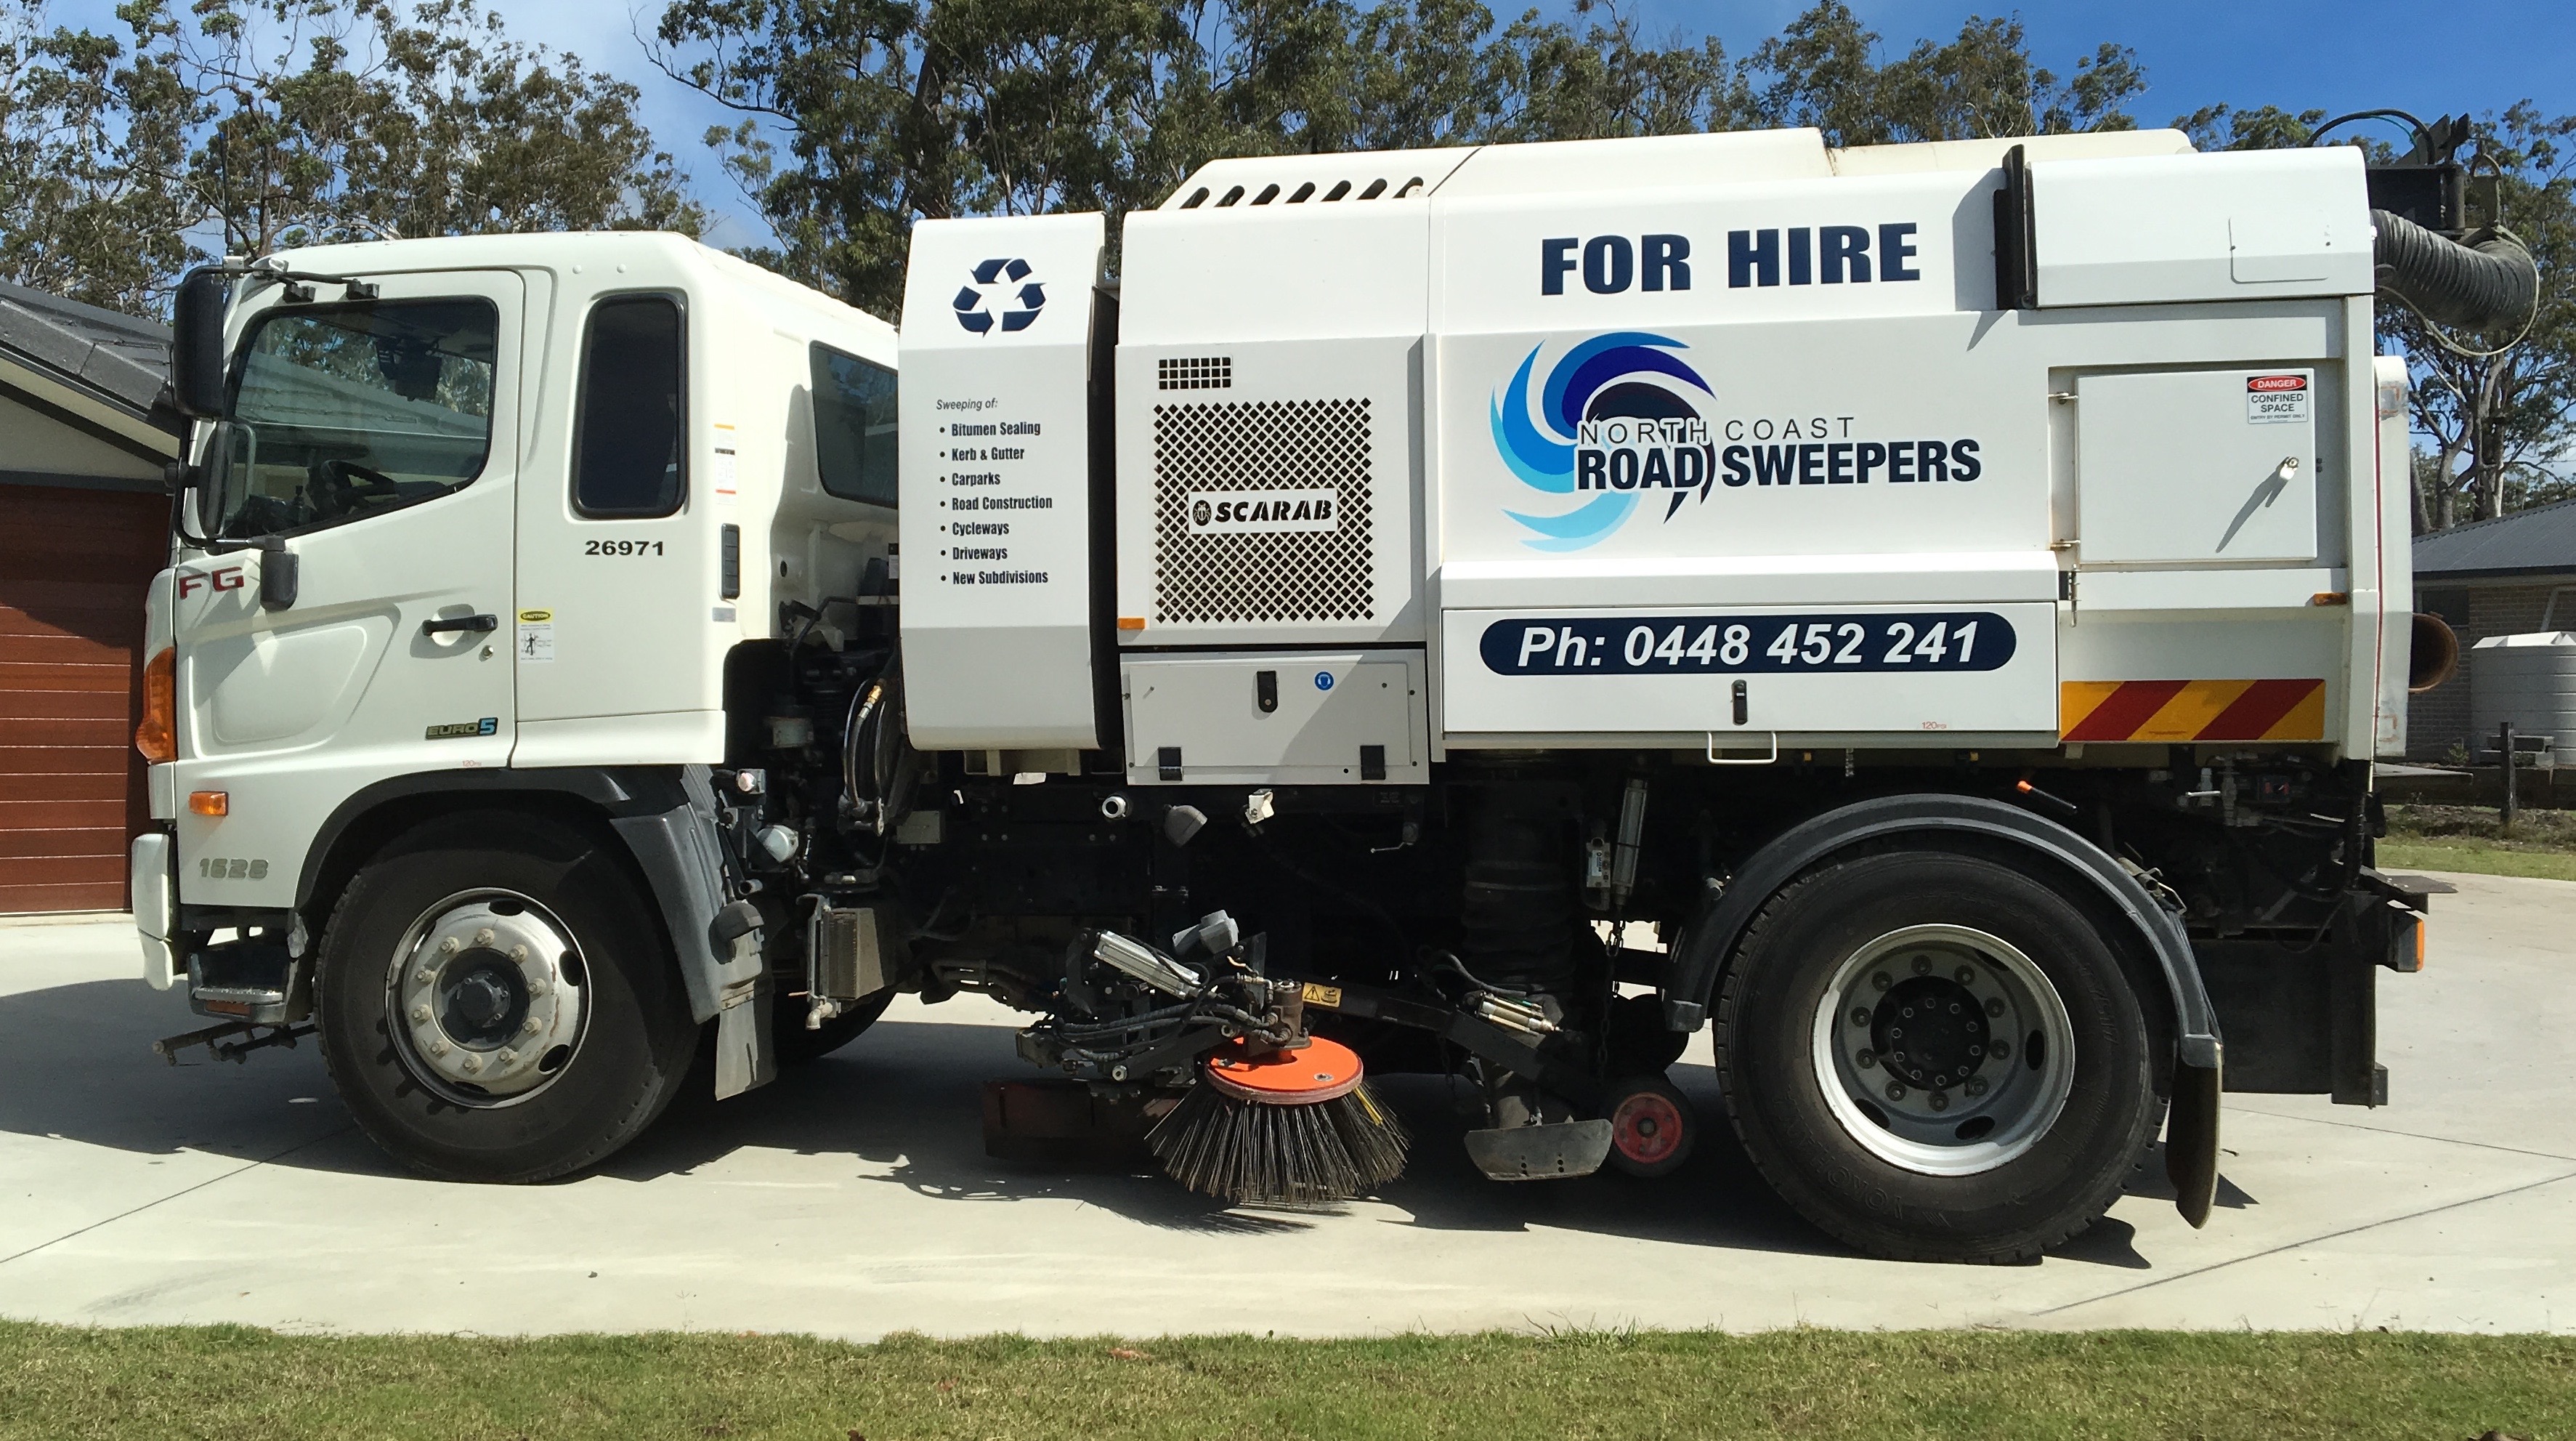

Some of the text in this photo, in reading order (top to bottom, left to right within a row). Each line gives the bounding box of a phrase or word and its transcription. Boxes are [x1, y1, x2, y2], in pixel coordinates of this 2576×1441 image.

[1541, 222, 1920, 296] FOR HIRE
[2257, 379, 2296, 389] DANGER
[936, 397, 998, 411] Sweeping of:
[2251, 393, 2304, 403] CONFINED
[2261, 403, 2295, 413] SPACE
[952, 421, 1041, 436] Bitumen Sealing
[1578, 417, 1855, 443] NORTH COAST
[952, 447, 1024, 461] Kerb & Gutter
[1577, 439, 1981, 491] ROAD SWEEPERS
[952, 472, 1000, 486] Carparks
[952, 496, 1053, 510] Road Construction
[1215, 499, 1332, 522] SCARAB
[952, 522, 1009, 536] Cycleways
[584, 539, 665, 556] 26971
[952, 546, 1008, 560] Driveways
[178, 566, 245, 600] FG
[952, 570, 1048, 584] New Subdivisions
[1518, 621, 1978, 667] Ph: 0448 452 241
[199, 857, 269, 879] 1628
